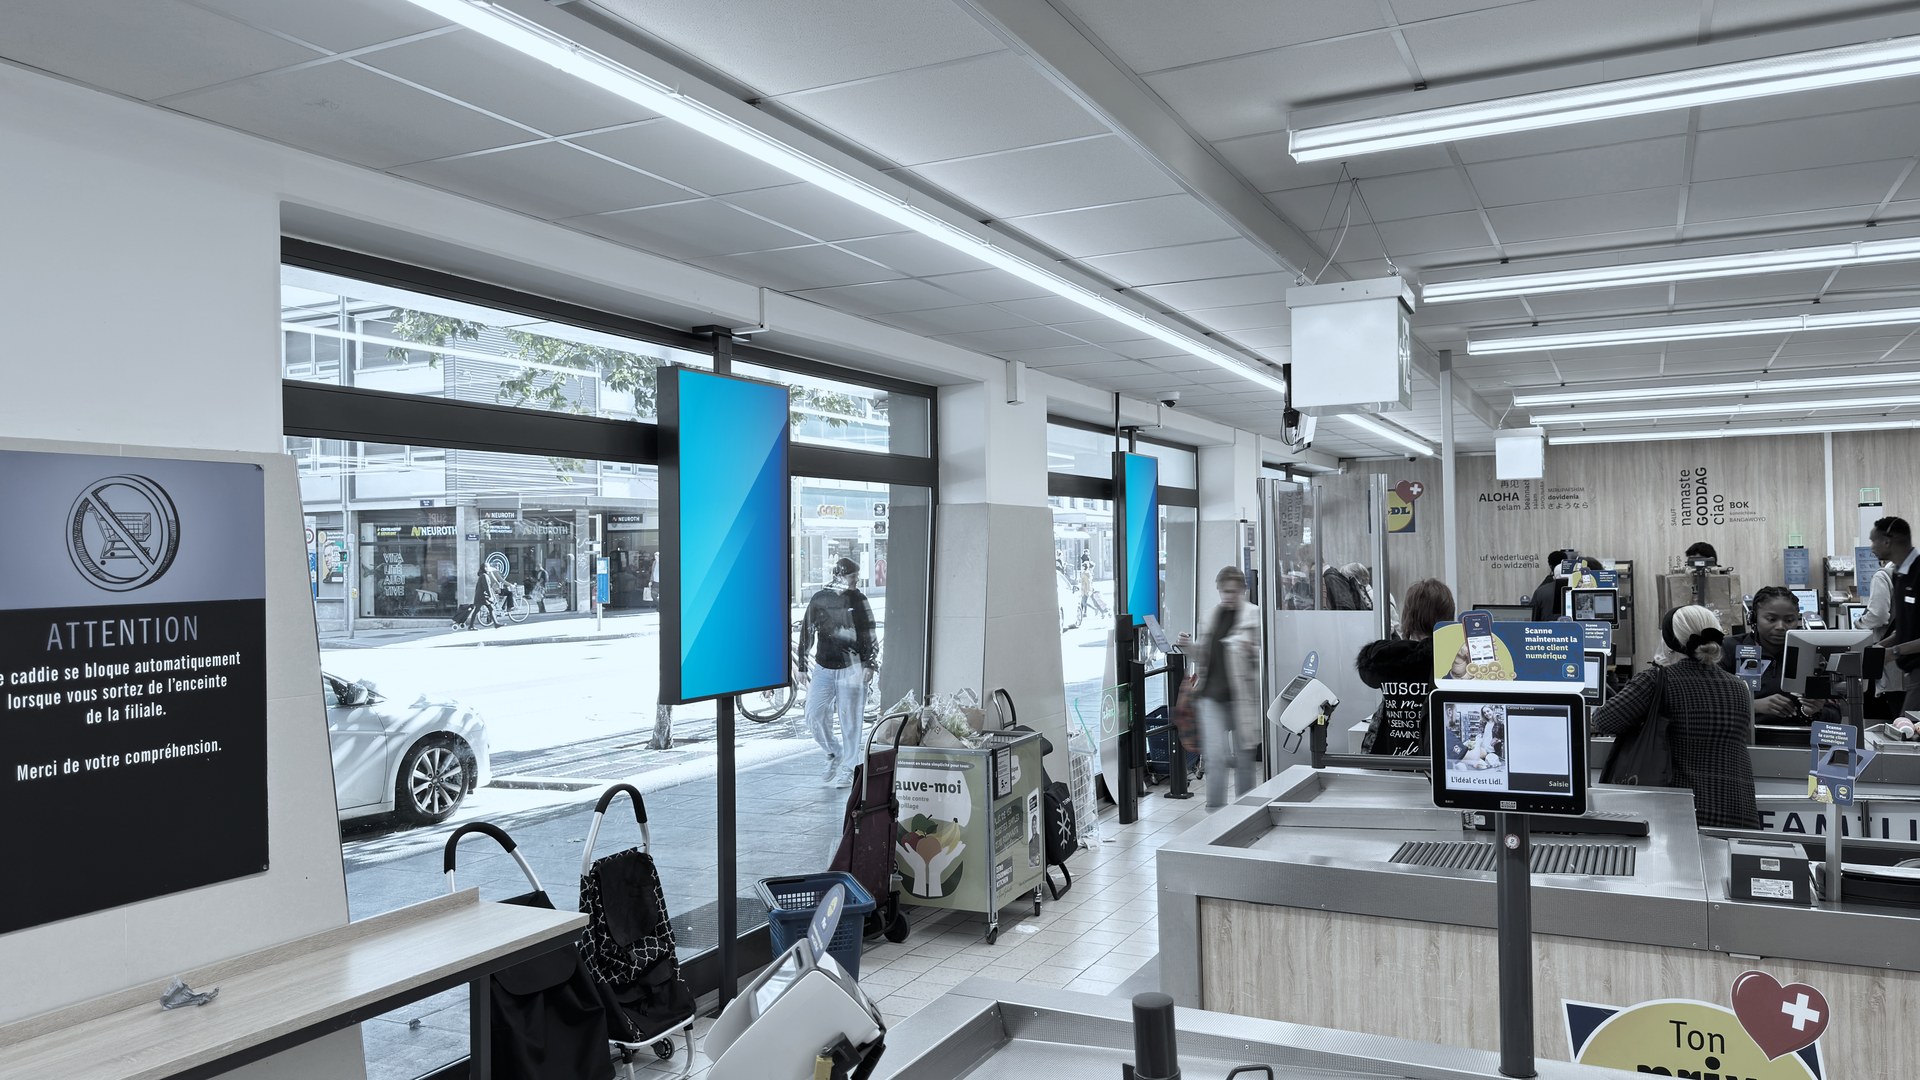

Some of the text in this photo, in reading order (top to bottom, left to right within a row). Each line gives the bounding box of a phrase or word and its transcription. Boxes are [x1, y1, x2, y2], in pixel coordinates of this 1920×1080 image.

[1479, 493, 1519, 502] ALOHA
[1679, 469, 1691, 526] namaste
[1695, 467, 1708, 526] GODDAG
[1388, 506, 1410, 515] DL
[1497, 503, 1521, 511] selam
[1710, 494, 1725, 525] ciao
[1729, 501, 1749, 509] BOK
[421, 525, 457, 537] NEUROTH
[534, 526, 568, 535] NEUROTH
[1504, 561, 1540, 569] widzenia
[47, 615, 198, 650] ATTENTION
[1525, 652, 1567, 661] numérique
[0, 651, 241, 686] e caddie se bloque automatiquement
[8, 674, 228, 709] lorsque vous sortez de l'enceinte
[86, 702, 167, 725] de la filiale.
[1404, 711, 1416, 719] TO
[17, 739, 222, 781] Merci de votre compréhension.
[1451, 776, 1503, 785] L'idéal c'est Lidl.
[1549, 780, 1569, 788] Saisie
[895, 780, 961, 795] auve-moi
[1669, 1020, 1726, 1055] Ton
